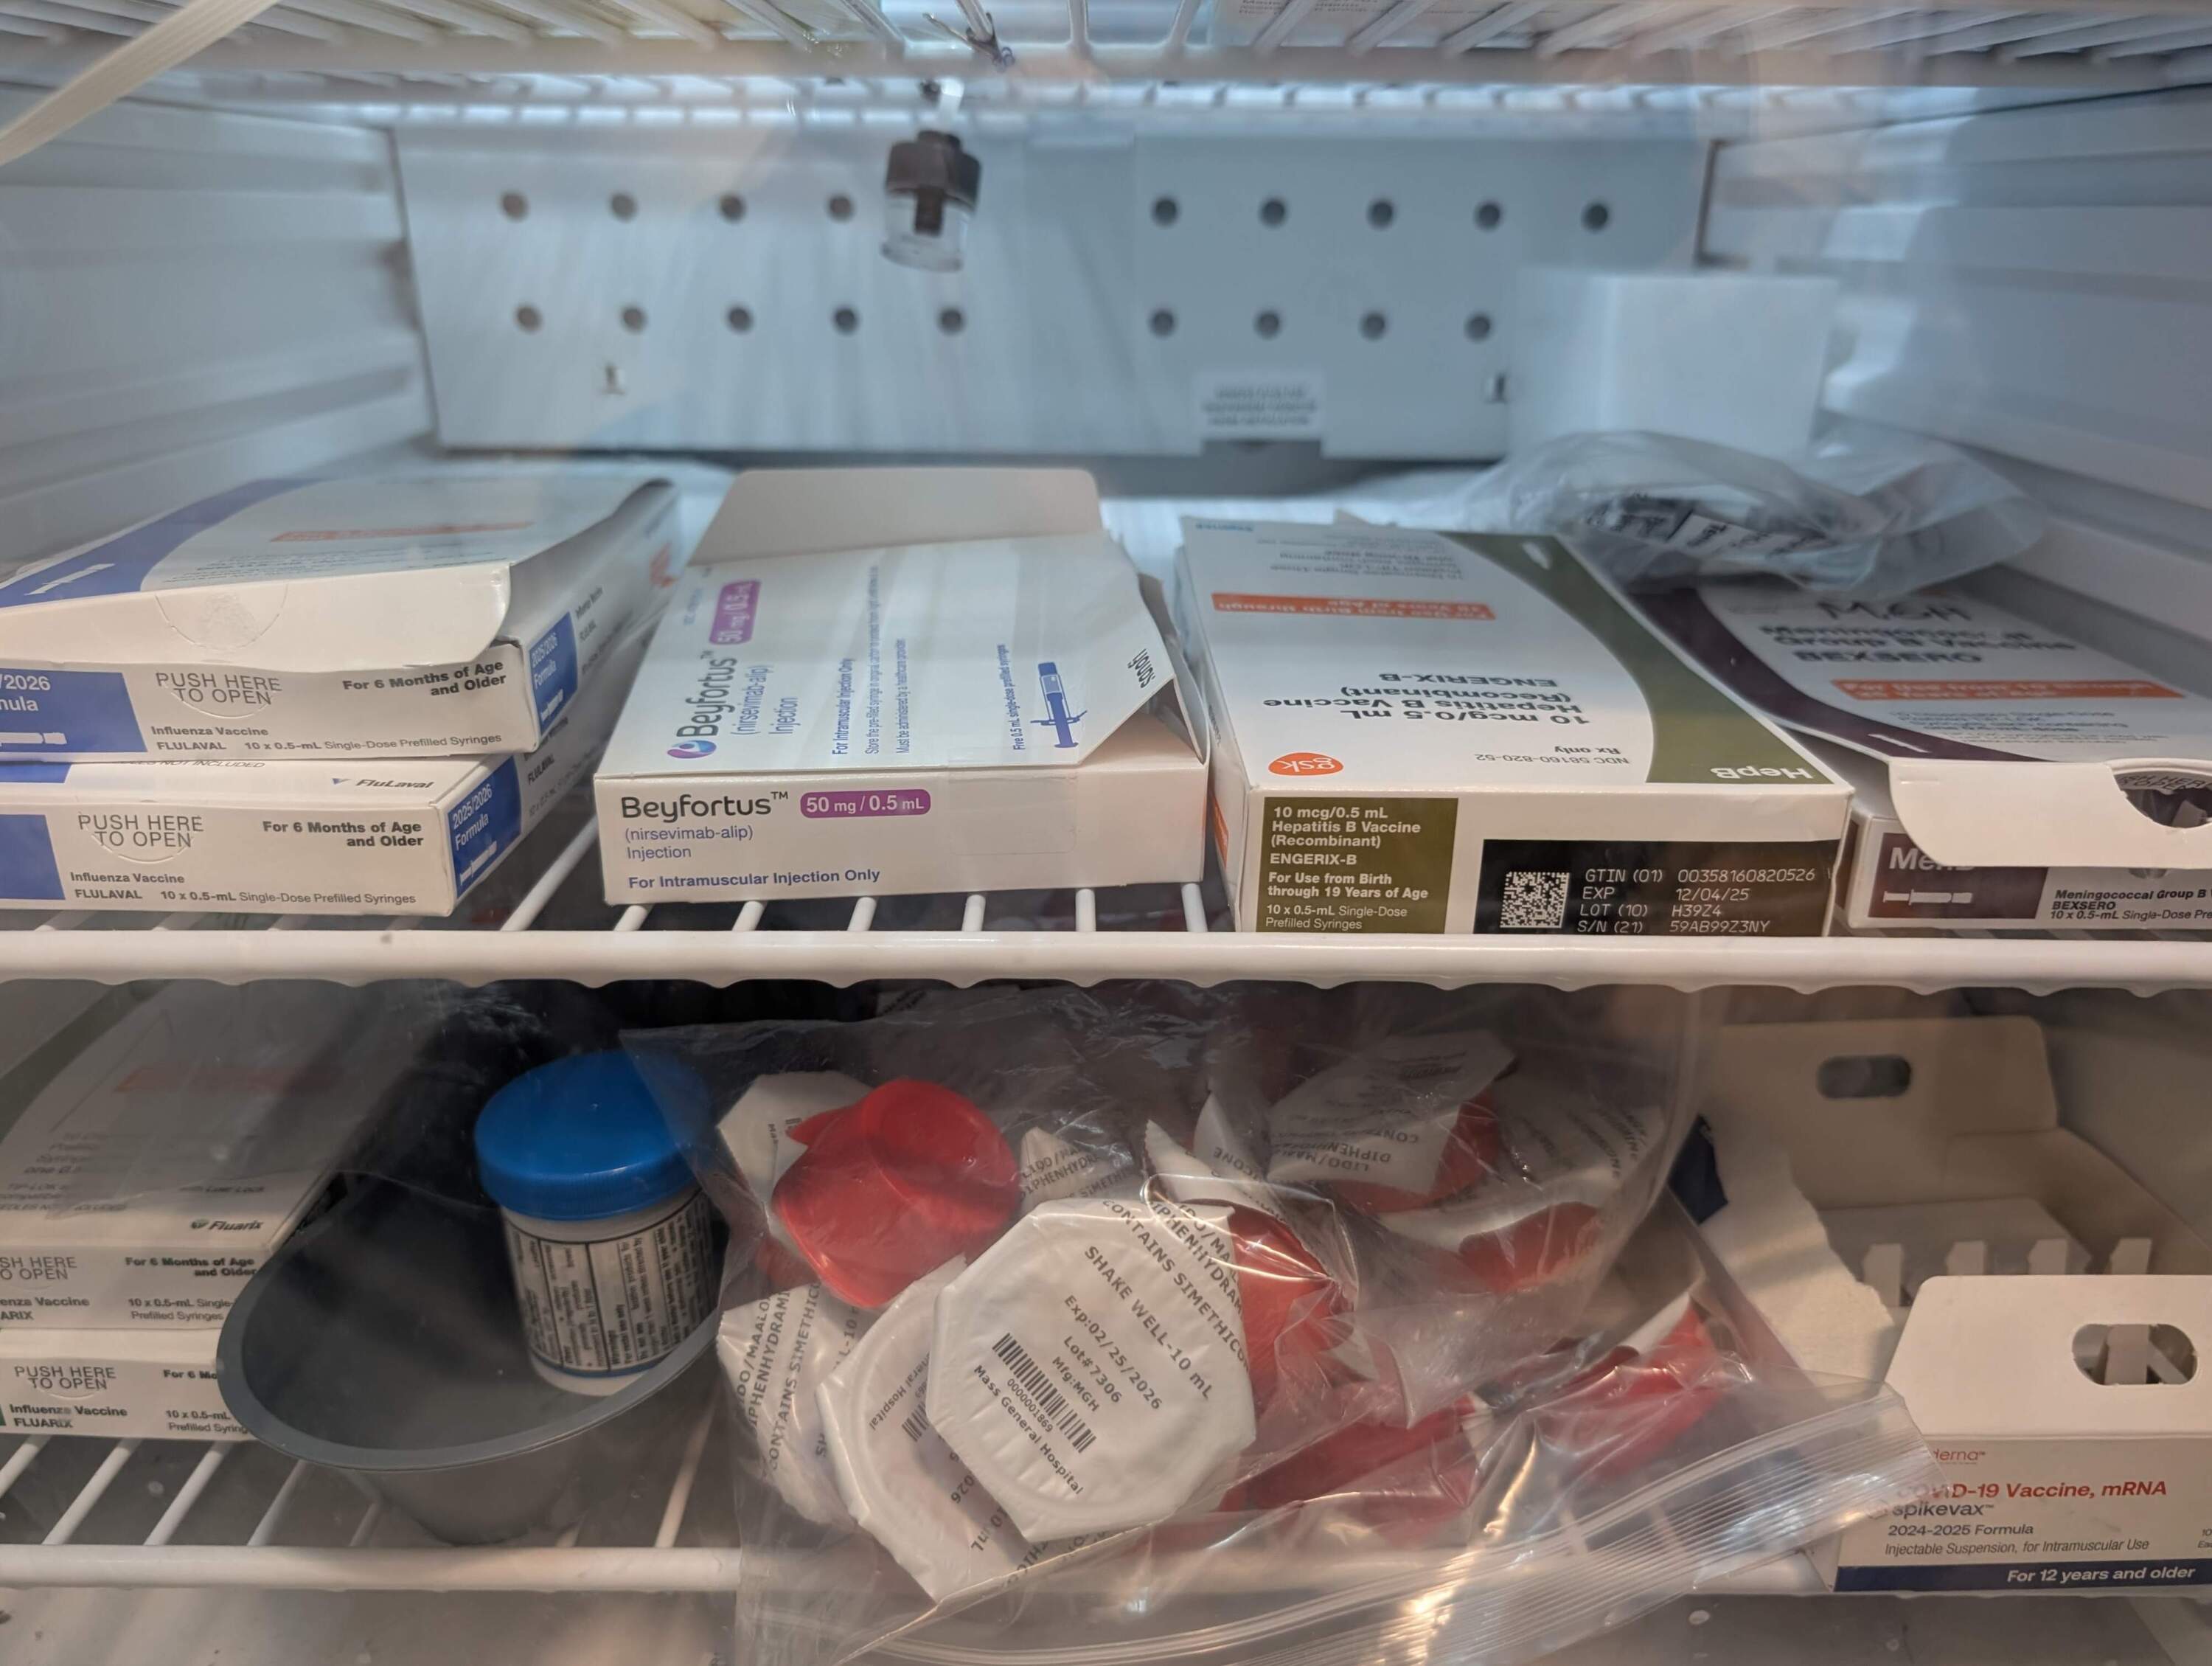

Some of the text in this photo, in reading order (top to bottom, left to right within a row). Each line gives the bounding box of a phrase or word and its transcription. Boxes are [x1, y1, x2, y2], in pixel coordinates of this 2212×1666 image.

[156, 673, 282, 692] PUSH HERE
[342, 661, 504, 692] For 6 Months of Age
[1380, 673, 1556, 687] ENGERIX-B
[430, 674, 507, 696] and Older
[174, 689, 273, 706] TO OPEN
[731, 665, 774, 735] (nirsevimab-alip)
[1340, 686, 1571, 703] (Recombinant)
[1004, 689, 1020, 718] single-dose
[1263, 698, 1581, 714] Hepatitis B Vaccine
[769, 697, 801, 735] Injection
[1340, 709, 1590, 725] 10 mcg/0.5 mL
[151, 726, 268, 737] Influenza Vaccine
[896, 698, 910, 754] Must administered
[157, 734, 502, 751] FLULAVAL 10 0.5-mL Single-Dose Prefilled Syringes
[865, 738, 880, 754] Store
[1013, 738, 1026, 751] Five
[1554, 745, 1621, 755] Rx only
[193, 760, 266, 768] INCLUDED
[1278, 755, 1336, 773] gsk
[1475, 754, 1630, 766] NDC 58160-820-52
[1714, 766, 1813, 780] HepB
[355, 778, 435, 789] FluLaval
[453, 783, 493, 830] 2025/2026
[806, 796, 830, 813] 50
[834, 800, 856, 815] mg
[869, 794, 897, 811] 0.5
[902, 796, 924, 811] mL
[1274, 807, 1388, 820] 10 mcg/0.5 mL
[78, 814, 204, 832] PUSH HERE
[1273, 821, 1421, 834] Hepatitis B Vaccine
[95, 832, 192, 848] TO OPEN
[456, 815, 490, 851] Formula
[625, 824, 754, 841] (nirsevimab-alip)
[1270, 835, 1381, 848] (Recombinant)
[627, 846, 692, 861] Injection
[1270, 853, 1357, 865] ENGERIX-B
[70, 871, 184, 884] Influenza Vaccine
[628, 869, 880, 889] For Intramuscular Injection Only
[1268, 872, 1392, 884] For Use from Birth
[1585, 868, 1816, 883] GTIN (01) 00358160820526
[74, 889, 416, 906] FLULAVAL 10 0.5-mL Single-Dose Prefilled Syringes
[1267, 886, 1428, 900] through 19 Years of Age
[1582, 886, 1751, 901] EXP 12/04/25
[2055, 889, 2154, 900] Meningococcal
[2157, 889, 2193, 901] Group
[2197, 889, 2206, 899] B
[1267, 904, 1408, 918] 10 0.5-mL Single-Dose
[1579, 903, 1722, 918] LOT (10) H39Z4
[2052, 901, 2116, 911] BEXSERO
[1265, 917, 1363, 931] Prefilled Syringes
[2051, 911, 2062, 920] 10
[2077, 911, 2120, 920] 0.5-mL
[2122, 911, 2191, 922] Single-Dose
[1577, 920, 1772, 934] S/N (21) 59AB99Z3NY
[1102, 1199, 1177, 1273] CONTAINS
[37, 1297, 90, 1307] Vaccine
[1085, 1245, 1133, 1301] SHAKE
[1132, 1299, 1192, 1372] WELL-10
[1189, 1371, 1214, 1400] mL
[1064, 1294, 1163, 1410] Exp:02/25/2026
[14, 1366, 116, 1379] PUSH HERE
[1063, 1336, 1122, 1403] Lot#7306
[28, 1378, 108, 1390] TO OPEN
[1052, 1356, 1100, 1412] Mfg:MGH
[10, 1404, 128, 1417] Influenza Vaccine
[869, 1385, 908, 1431] Hospital
[1006, 1378, 1054, 1433] 0000001869
[14, 1409, 180, 1429] FLUARIX 10
[169, 1422, 211, 1432] Prefilled
[769, 1377, 798, 1471] CONTAINS
[974, 1364, 1085, 1496] Mass General Hospital
[2006, 1482, 2096, 1500] Vaccine,
[2101, 1481, 2167, 1497] mRNA
[1888, 1524, 2034, 1536] 2024-2025 Formula
[1885, 1538, 2150, 1555] Injectable Suspension, for Intramuscular Use
[2007, 1566, 2197, 1585] For 12 years and older
